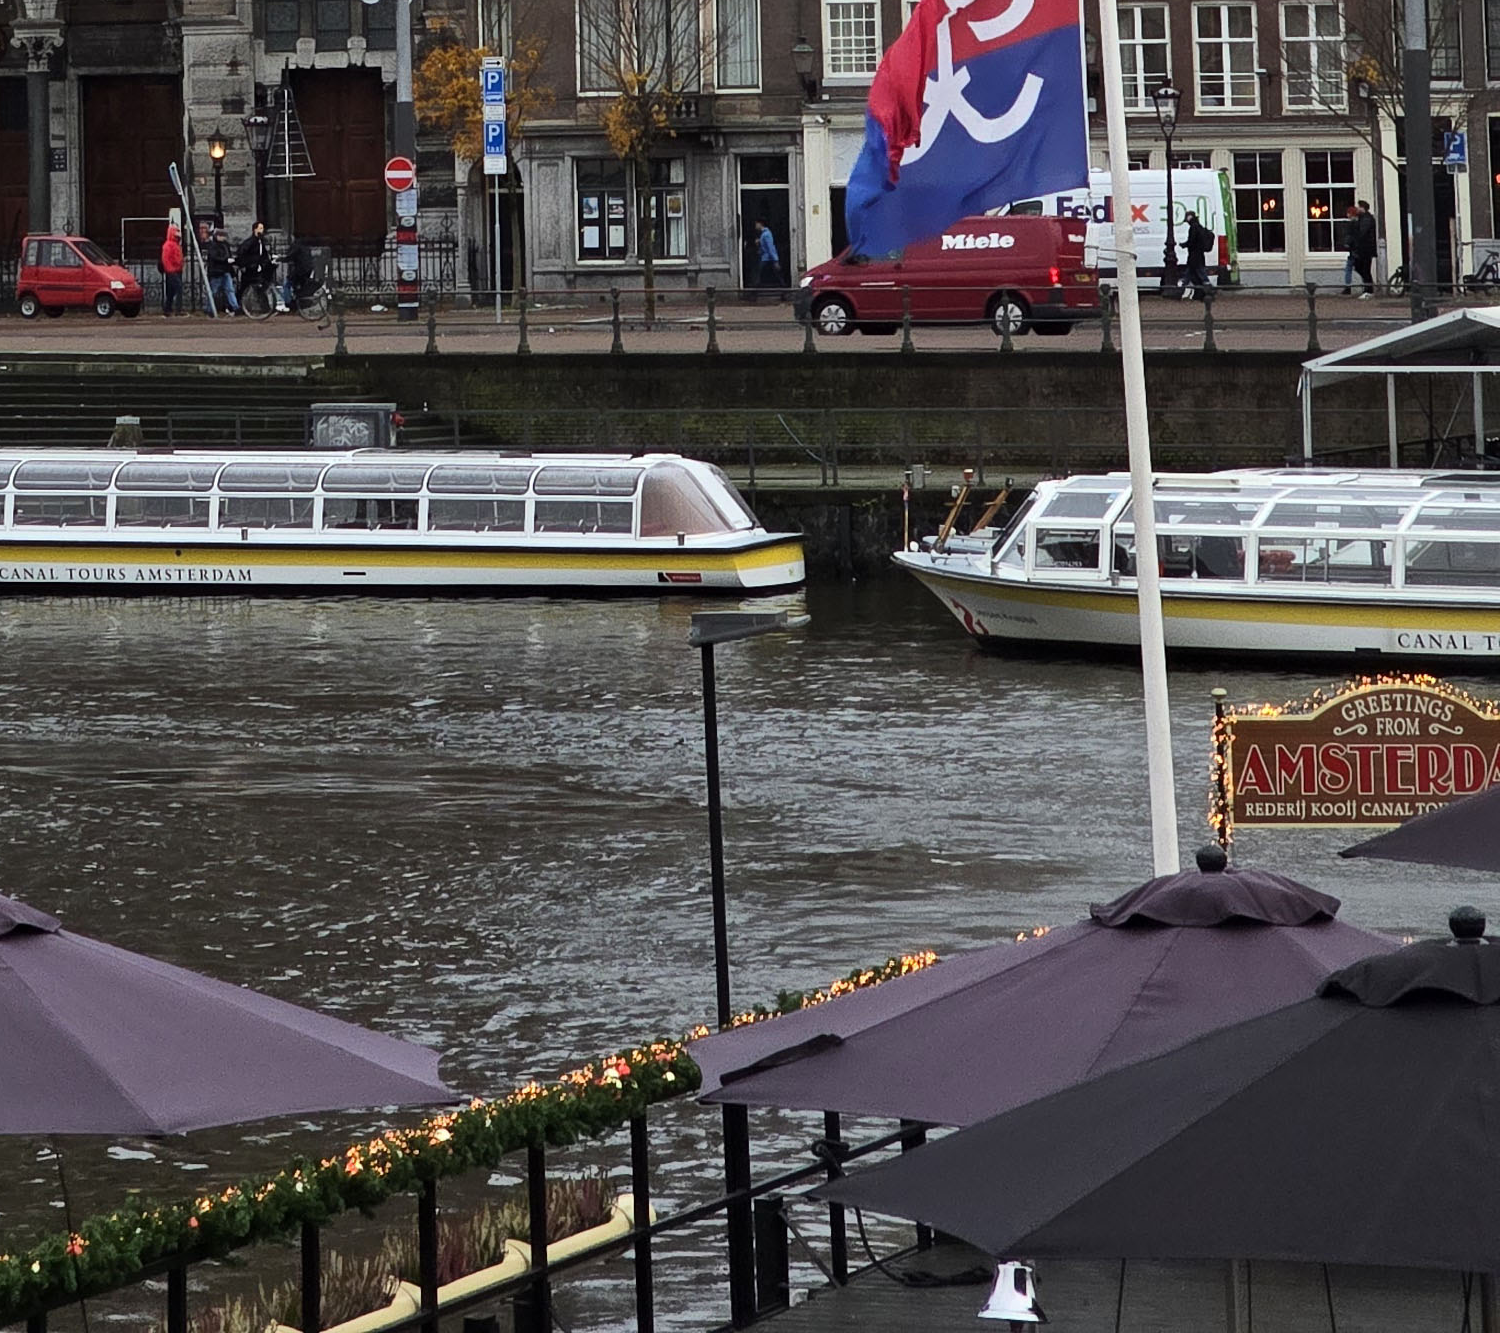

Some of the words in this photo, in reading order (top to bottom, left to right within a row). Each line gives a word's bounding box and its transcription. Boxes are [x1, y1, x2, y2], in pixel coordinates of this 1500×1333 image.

[1056, 196, 1150, 223] Fedx
[941, 232, 1015, 250] Miele
[66, 568, 126, 581] TOURS
[135, 568, 253, 582] AMSTERDAM
[1397, 633, 1473, 651] CANAL
[1482, 635, 1500, 651] T
[1341, 693, 1455, 722] GREETINGS
[1376, 717, 1420, 736] FROM
[1361, 802, 1414, 816] CANAL
